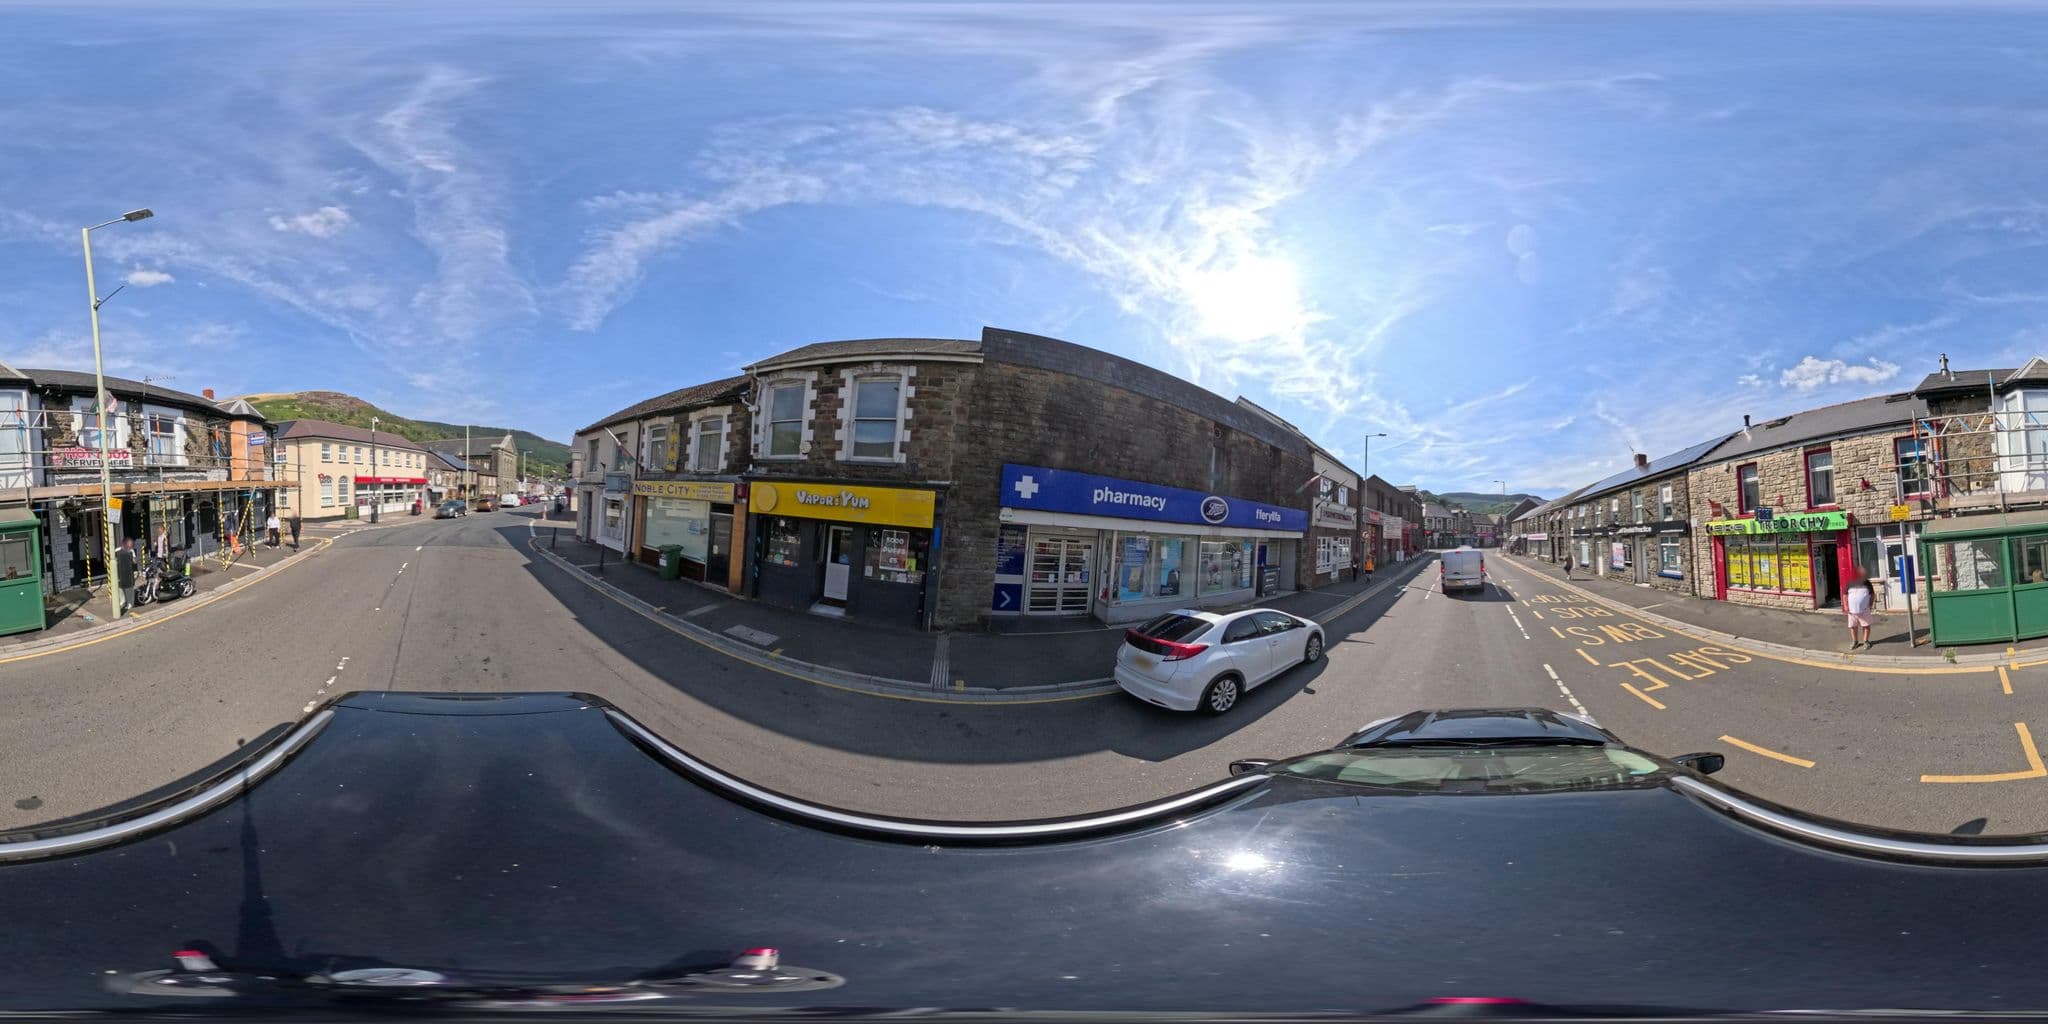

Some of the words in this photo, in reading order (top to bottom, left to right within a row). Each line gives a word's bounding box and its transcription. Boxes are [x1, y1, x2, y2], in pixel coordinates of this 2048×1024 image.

[635, 483, 664, 494] NOBLE
[667, 484, 690, 495] CITY
[796, 490, 833, 506] VAPOR
[840, 490, 869, 508] YUM
[1093, 486, 1166, 511] pharmacy
[1759, 516, 1826, 530] TREORCHY
[1531, 594, 1588, 604] STOP
[1550, 606, 1615, 619] BUS
[1566, 622, 1665, 646] BWS
[1608, 646, 1752, 692] SAFLE
